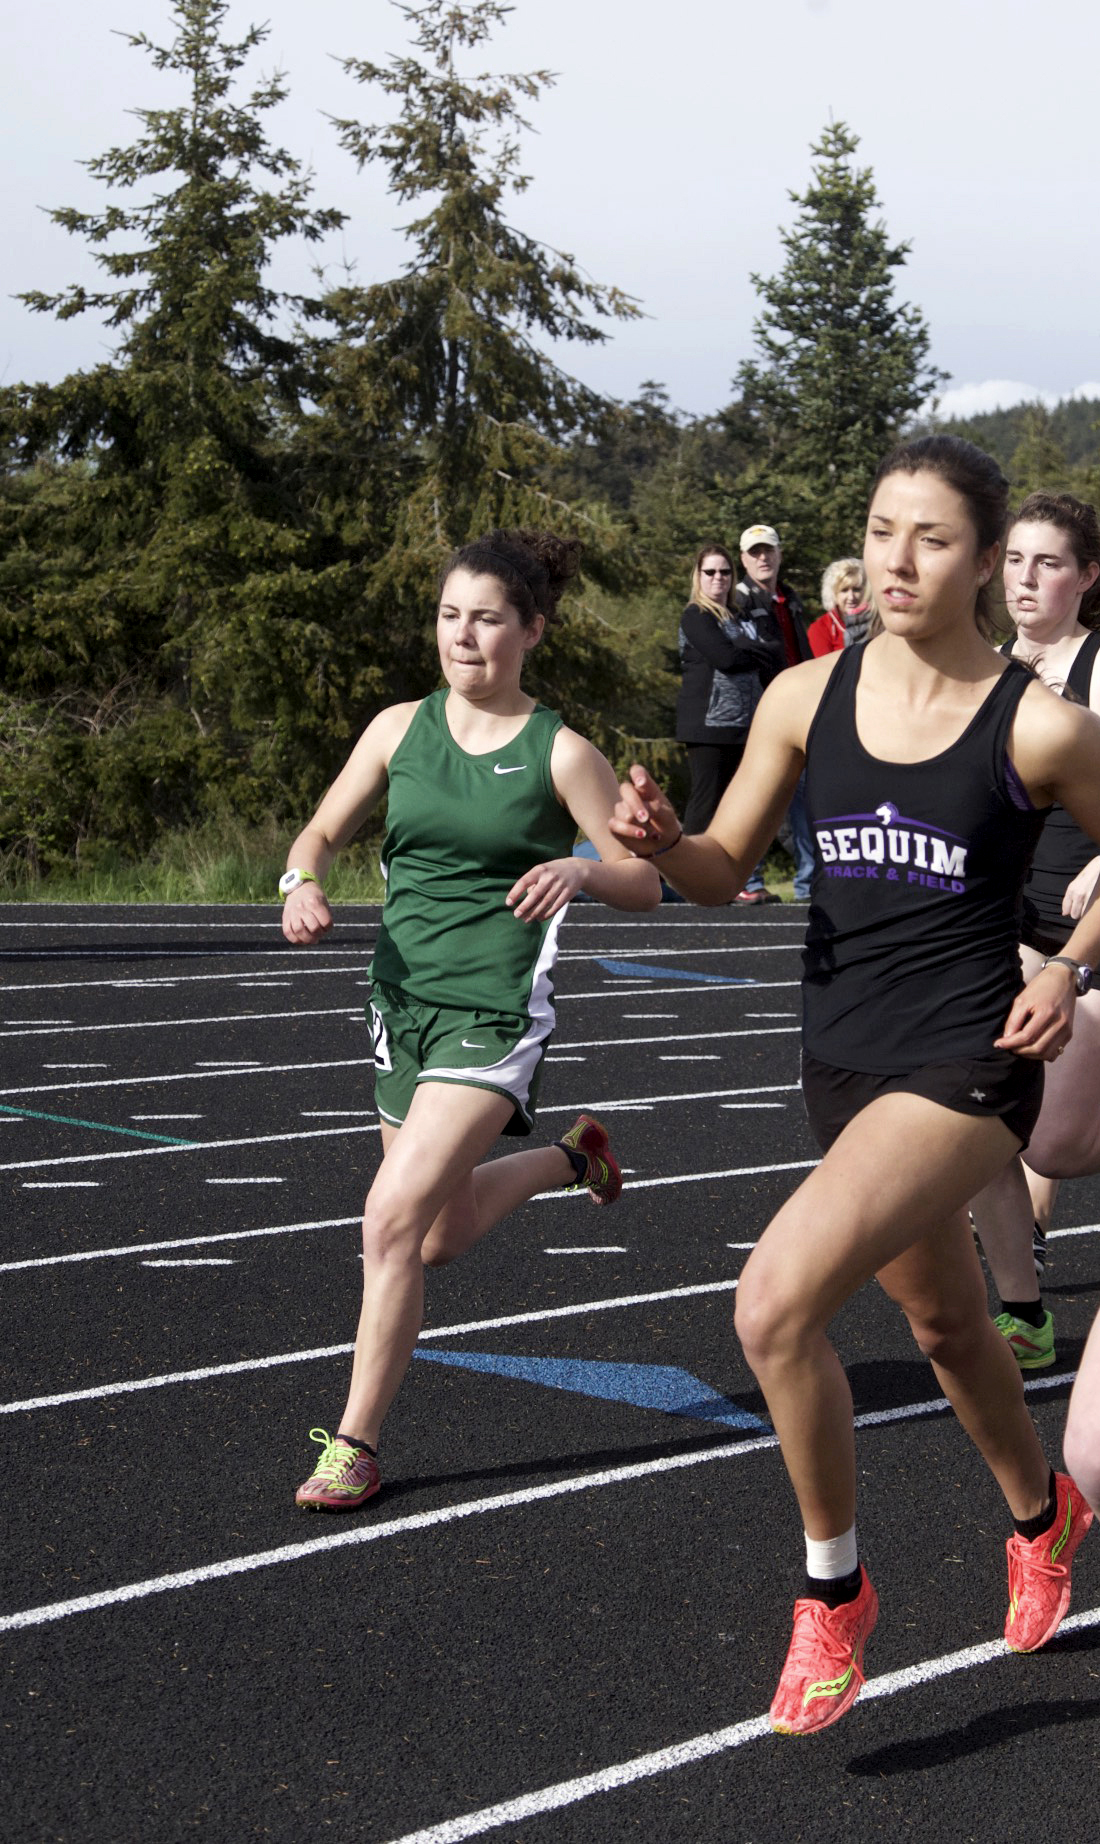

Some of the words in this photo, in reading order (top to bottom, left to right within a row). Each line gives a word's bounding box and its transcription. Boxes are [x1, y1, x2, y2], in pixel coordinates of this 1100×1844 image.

[816, 826, 968, 878] SEQUIM
[824, 865, 879, 879] TRACK
[886, 867, 900, 881] &
[907, 870, 966, 894] FIELD
[374, 1011, 386, 1066] 2
